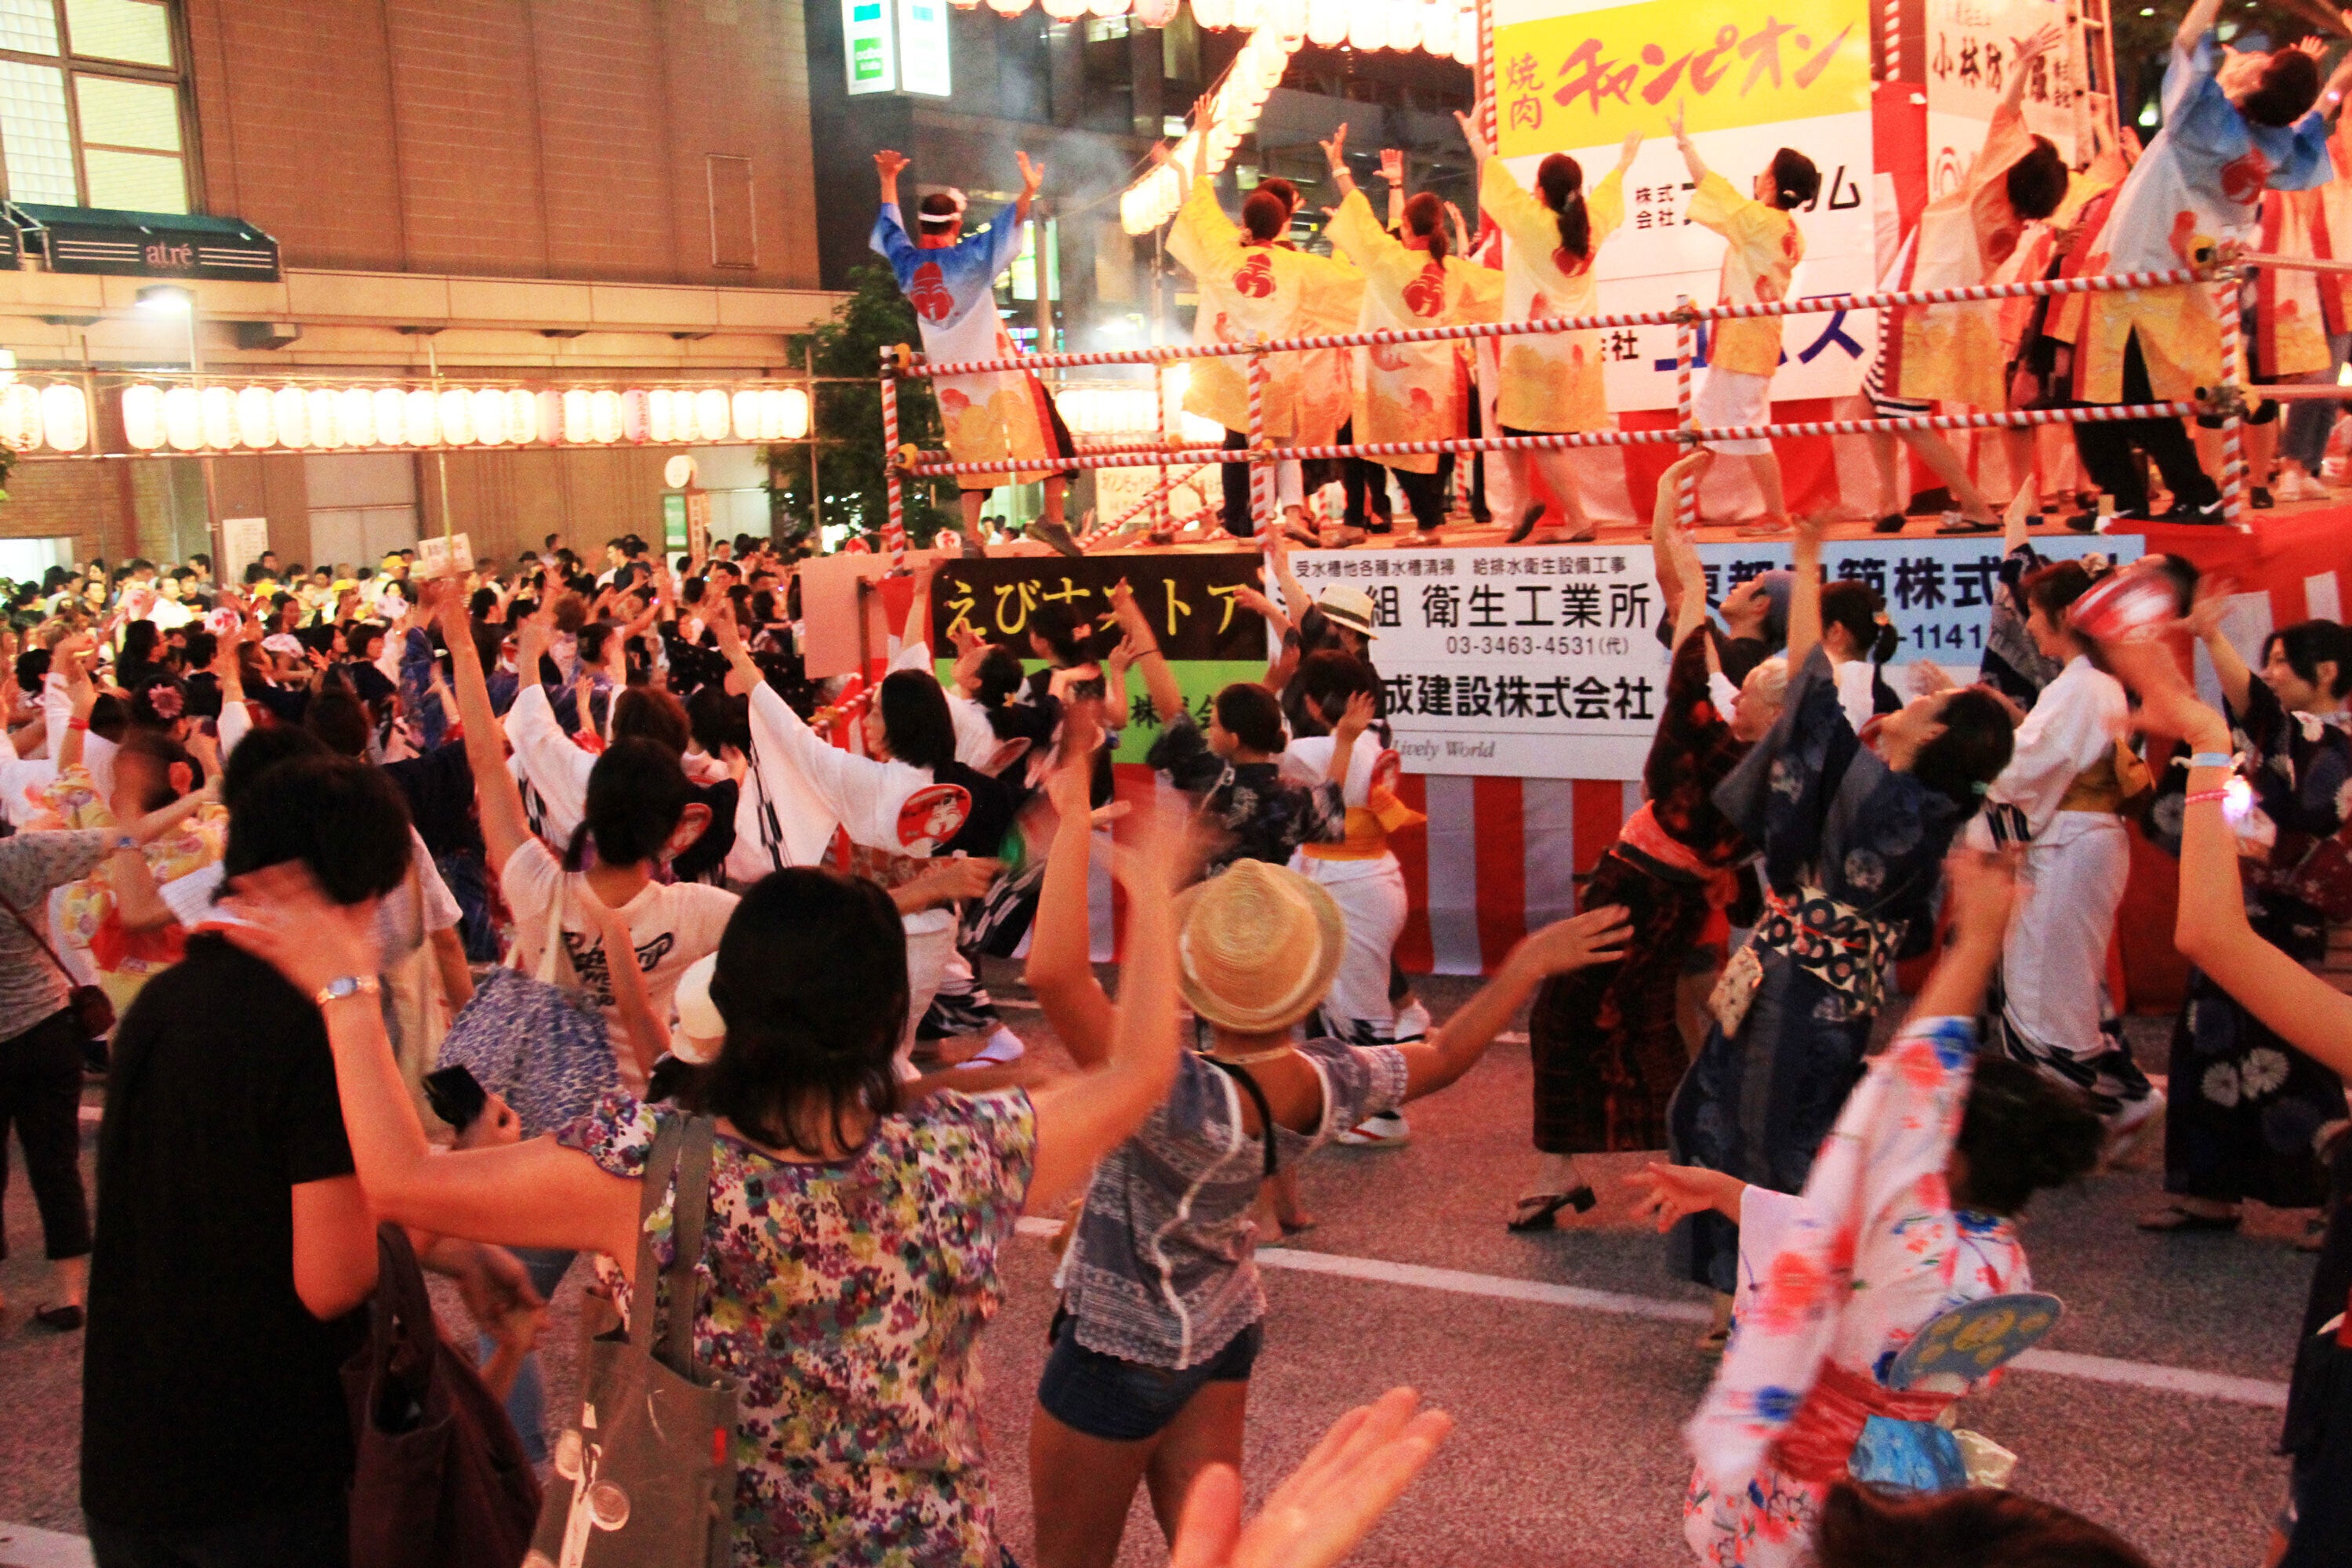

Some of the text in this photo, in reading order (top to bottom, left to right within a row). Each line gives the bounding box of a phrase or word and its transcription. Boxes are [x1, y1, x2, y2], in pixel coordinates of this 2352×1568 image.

[1505, 52, 1544, 131] 焼肉
[1552, 15, 1855, 116] チャンピオン
[145, 241, 193, 265] atré
